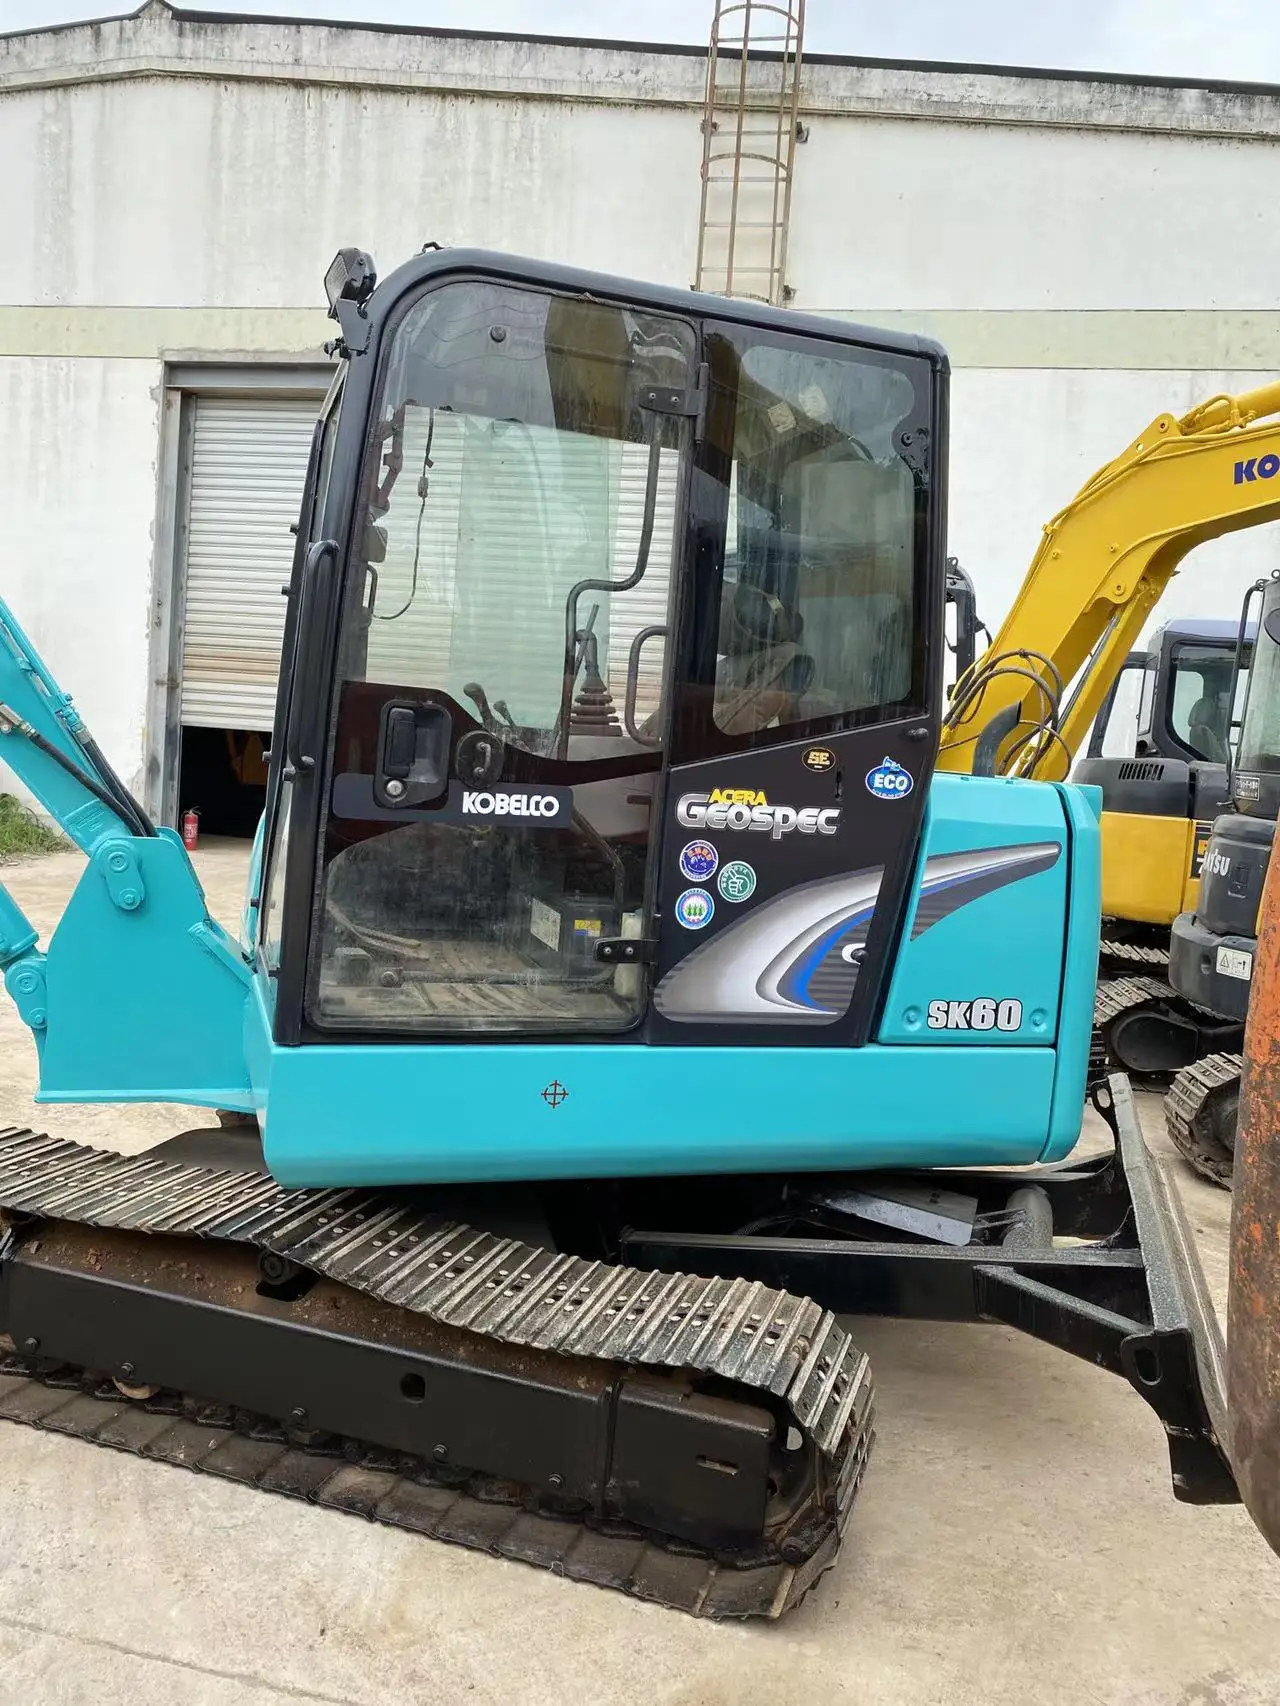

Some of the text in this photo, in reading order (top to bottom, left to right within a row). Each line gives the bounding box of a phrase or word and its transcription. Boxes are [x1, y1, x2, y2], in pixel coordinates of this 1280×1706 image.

[1234, 454, 1280, 485] KO
[873, 773, 909, 791] ECO
[462, 791, 560, 817] KOBELCO
[708, 788, 767, 807] ACERA
[927, 997, 1023, 1032] SK60
